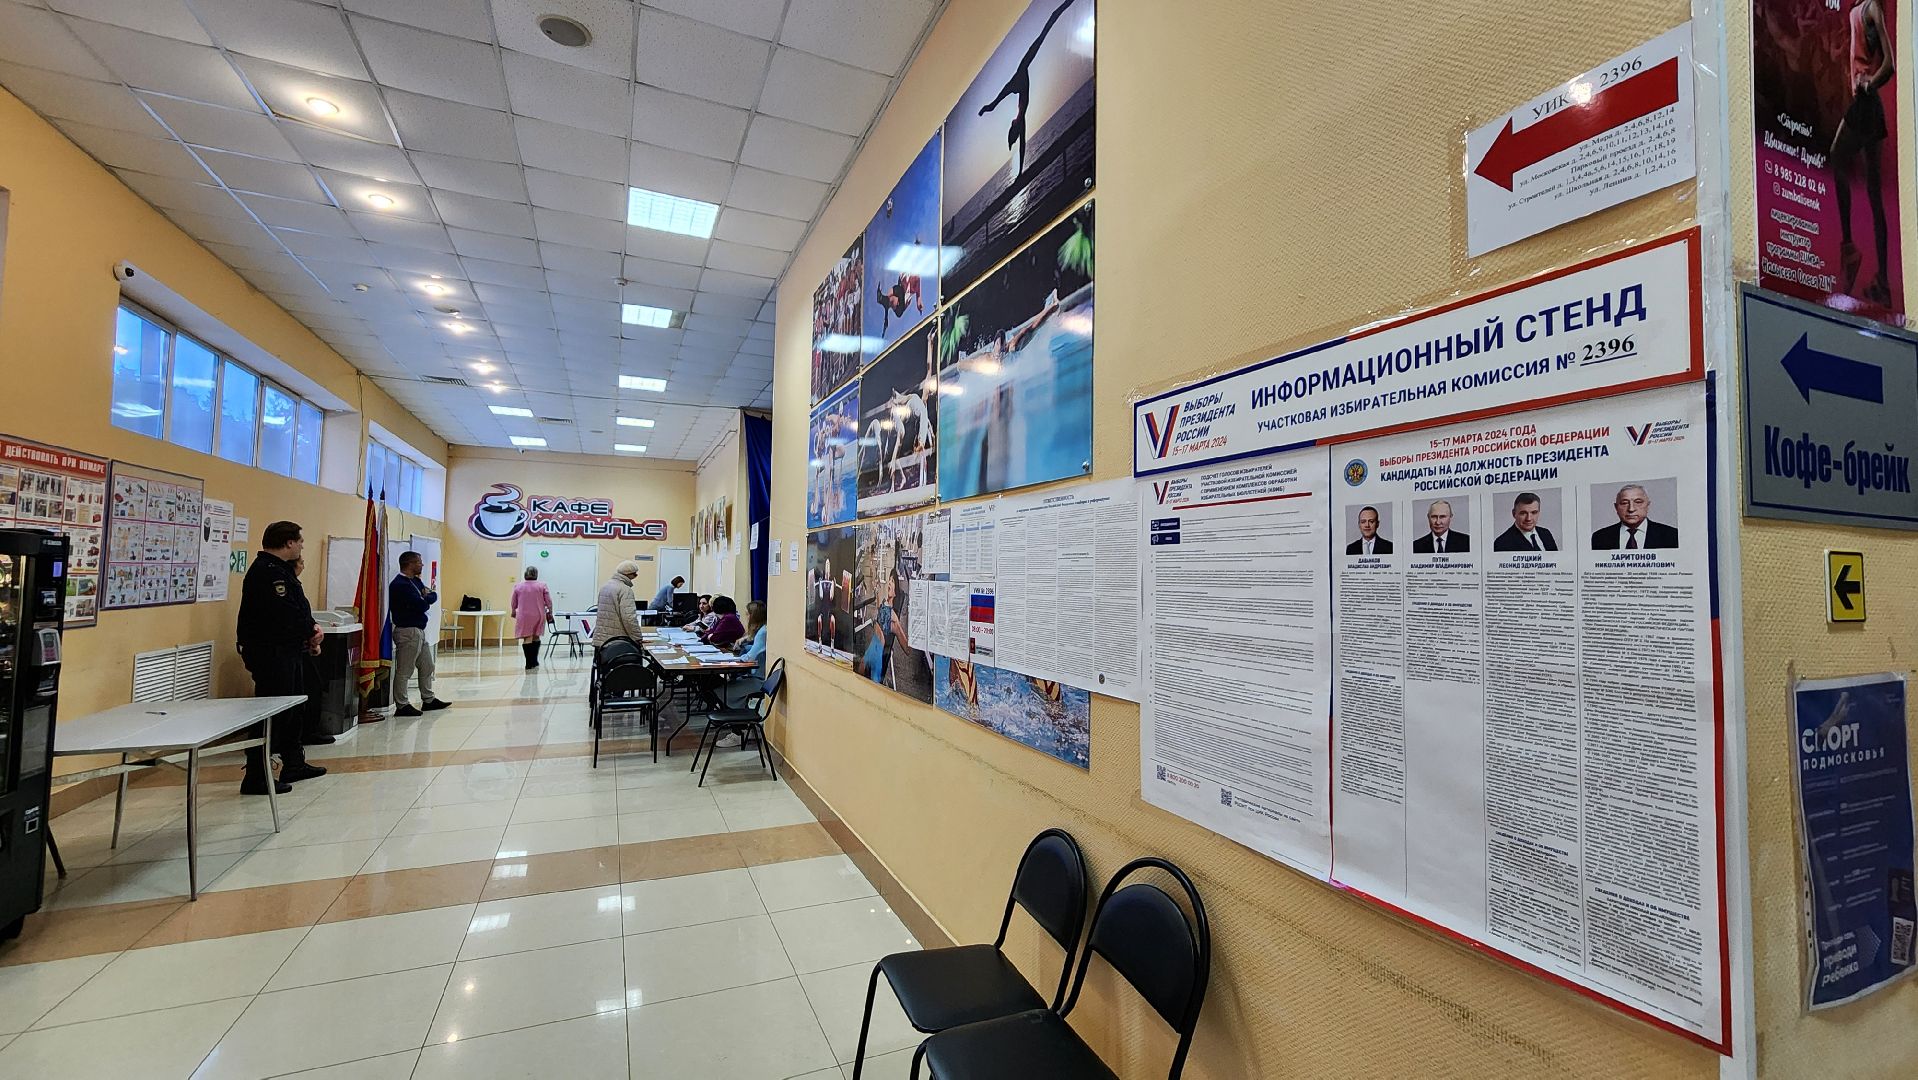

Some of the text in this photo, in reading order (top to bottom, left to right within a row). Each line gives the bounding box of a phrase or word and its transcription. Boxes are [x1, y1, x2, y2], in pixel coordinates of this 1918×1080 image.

[1532, 94, 1570, 119] УИК
[1600, 55, 1642, 87] 2396
[1571, 153, 1608, 174] Парковый
[1609, 144, 1637, 160] проезд
[1648, 127, 1676, 144] 2,4,6,8
[1592, 135, 1613, 146] Мира
[1764, 130, 1799, 158] Движение!
[1531, 161, 1570, 183] Московская
[1603, 175, 1632, 190] Ленина
[1644, 158, 1676, 175] 1,2,4,10
[1774, 163, 1826, 196] 8 985 228 02 64
[1519, 185, 1555, 205] Строителей
[1566, 176, 1603, 195] Школьная
[1251, 283, 1647, 410] ИНФОРМАЦИОННЫЙ СТЕНД
[1257, 334, 1635, 433] УЧАСТКОВАЯ ИЗБИРАТЕЛЬНАЯ КОМИССИЯ № 2396
[1184, 392, 1223, 413] ВЫБОРЫ
[1180, 404, 1236, 428] ПРЕЗИДЕНТА
[1175, 425, 1211, 443] РОССИИ
[1189, 440, 1210, 453] МАРТА
[1211, 435, 1228, 449] 2024
[1429, 424, 1537, 449] 15-17 МАРТА 2024 ГОДА
[1379, 426, 1610, 467] ВЫБОРЫ ПРЕЗИДЕНТА РОССИЙСКОЙ ФЕДЕРАЦИИ
[5, 445, 59, 465] ДЕЙСТВОВАТЬ
[62, 456, 77, 468] ПРИ
[80, 460, 105, 474] ПОЖАРЕ
[1380, 444, 1609, 482] КАНДИДАТЫ НА ДОЛЖНОСТЬ ПРЕЗИДЕНТА
[1764, 424, 1911, 495] Кофе-брейк
[1266, 468, 1297, 478] КОМИССИЕЙ
[1268, 477, 1298, 485] ОБРАБОТКИ
[1414, 467, 1558, 492] РОССИЙСКОЙ ФЕДЕРАЦИИ
[532, 500, 609, 514] КАФЕ
[531, 520, 663, 536] ИМПУЛЬС
[1512, 554, 1542, 563] СЛУЦКИЙ
[1595, 560, 1675, 568] НИКОЛАЙ МИХАЙЛОВИЧ
[1611, 553, 1657, 561] ХАРИТОНОВ
[1803, 747, 1885, 771] ПОДМОСКОВЬЯ
